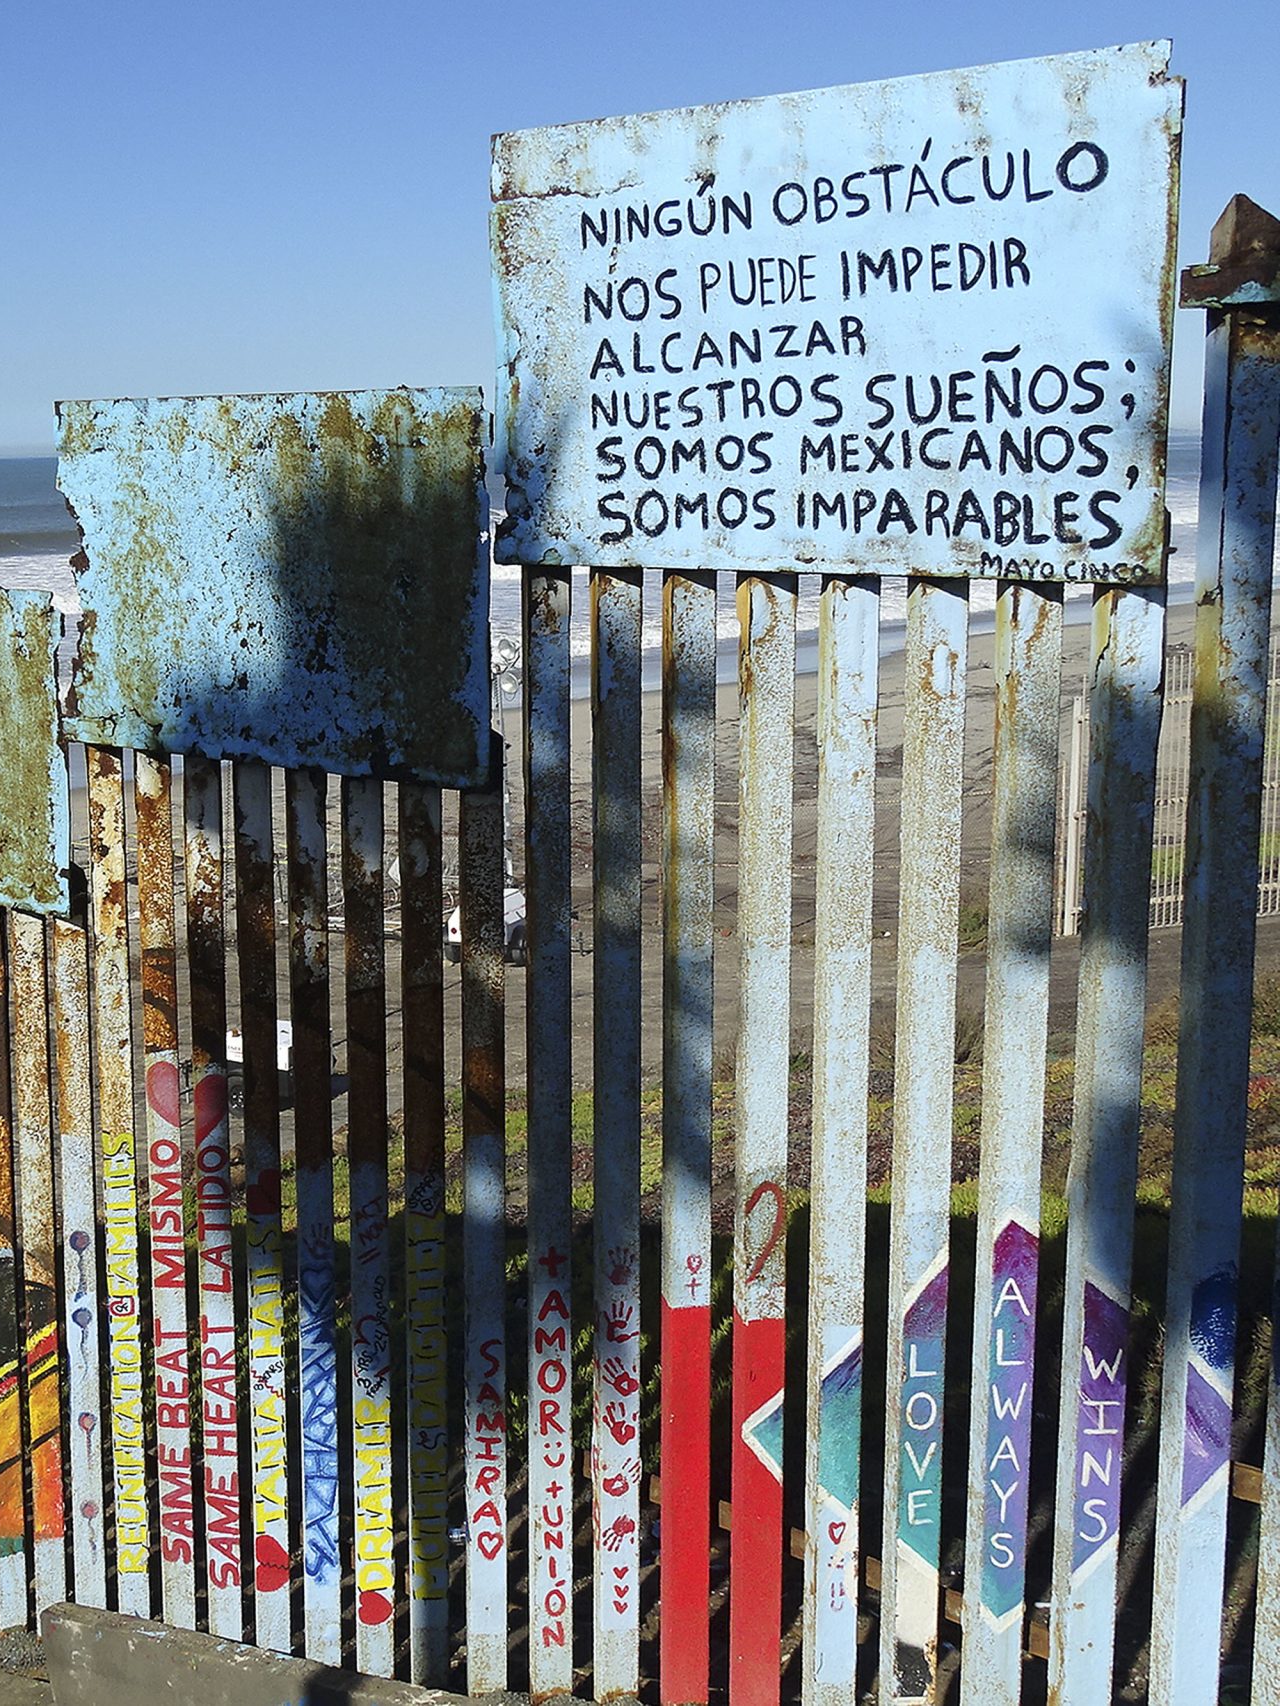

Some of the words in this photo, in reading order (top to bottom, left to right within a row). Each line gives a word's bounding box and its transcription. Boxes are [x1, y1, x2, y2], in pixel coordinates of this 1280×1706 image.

[580, 178, 753, 251] NINGÚN
[772, 138, 1110, 228] OBSTÁCULO
[583, 268, 683, 325] NOS
[699, 254, 818, 315] PUEDE
[840, 236, 1032, 302] IMPEDIR
[589, 315, 868, 380] ALCANZAR
[591, 372, 844, 432] NUESTROS
[595, 431, 775, 485] SOMOS
[597, 486, 778, 547] SOMOS
[796, 487, 1124, 551] IMPARABLES
[979, 550, 1055, 580] MAYO
[1064, 559, 1150, 583] CINCO
[102, 1131, 138, 1297] FAMILIES
[149, 1138, 188, 1290] MISMO
[196, 1143, 234, 1294] LATIDO
[153, 1316, 192, 1429] BEAT
[200, 1315, 239, 1458] HEART
[407, 1213, 448, 1430] DAUGHTER
[111, 1314, 150, 1576] REUNIFICATION
[253, 1397, 288, 1534] TANIA
[471, 1339, 508, 1528] SAMIRA
[905, 1344, 937, 1526] LOVE
[990, 1277, 1032, 1569] ALWAYS
[1080, 1345, 1123, 1544] WINS
[159, 1443, 194, 1565] SAME
[204, 1466, 242, 1590] SAME
[354, 1398, 393, 1593] DREAMER
